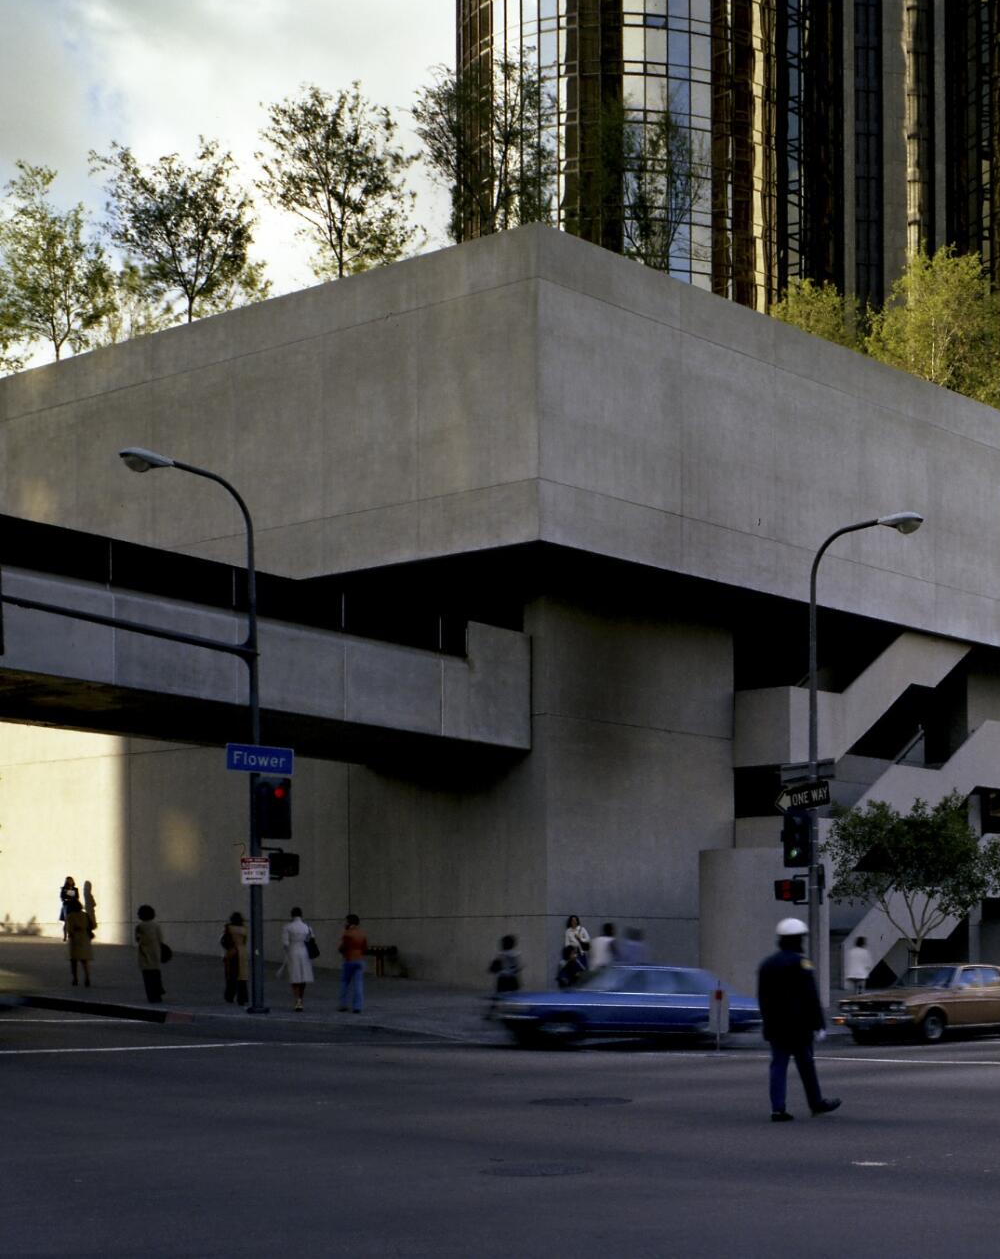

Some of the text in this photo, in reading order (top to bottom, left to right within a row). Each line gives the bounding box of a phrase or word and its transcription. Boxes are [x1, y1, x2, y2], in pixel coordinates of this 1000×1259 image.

[233, 751, 286, 768] Flower
[792, 786, 828, 806] ONE WAY
